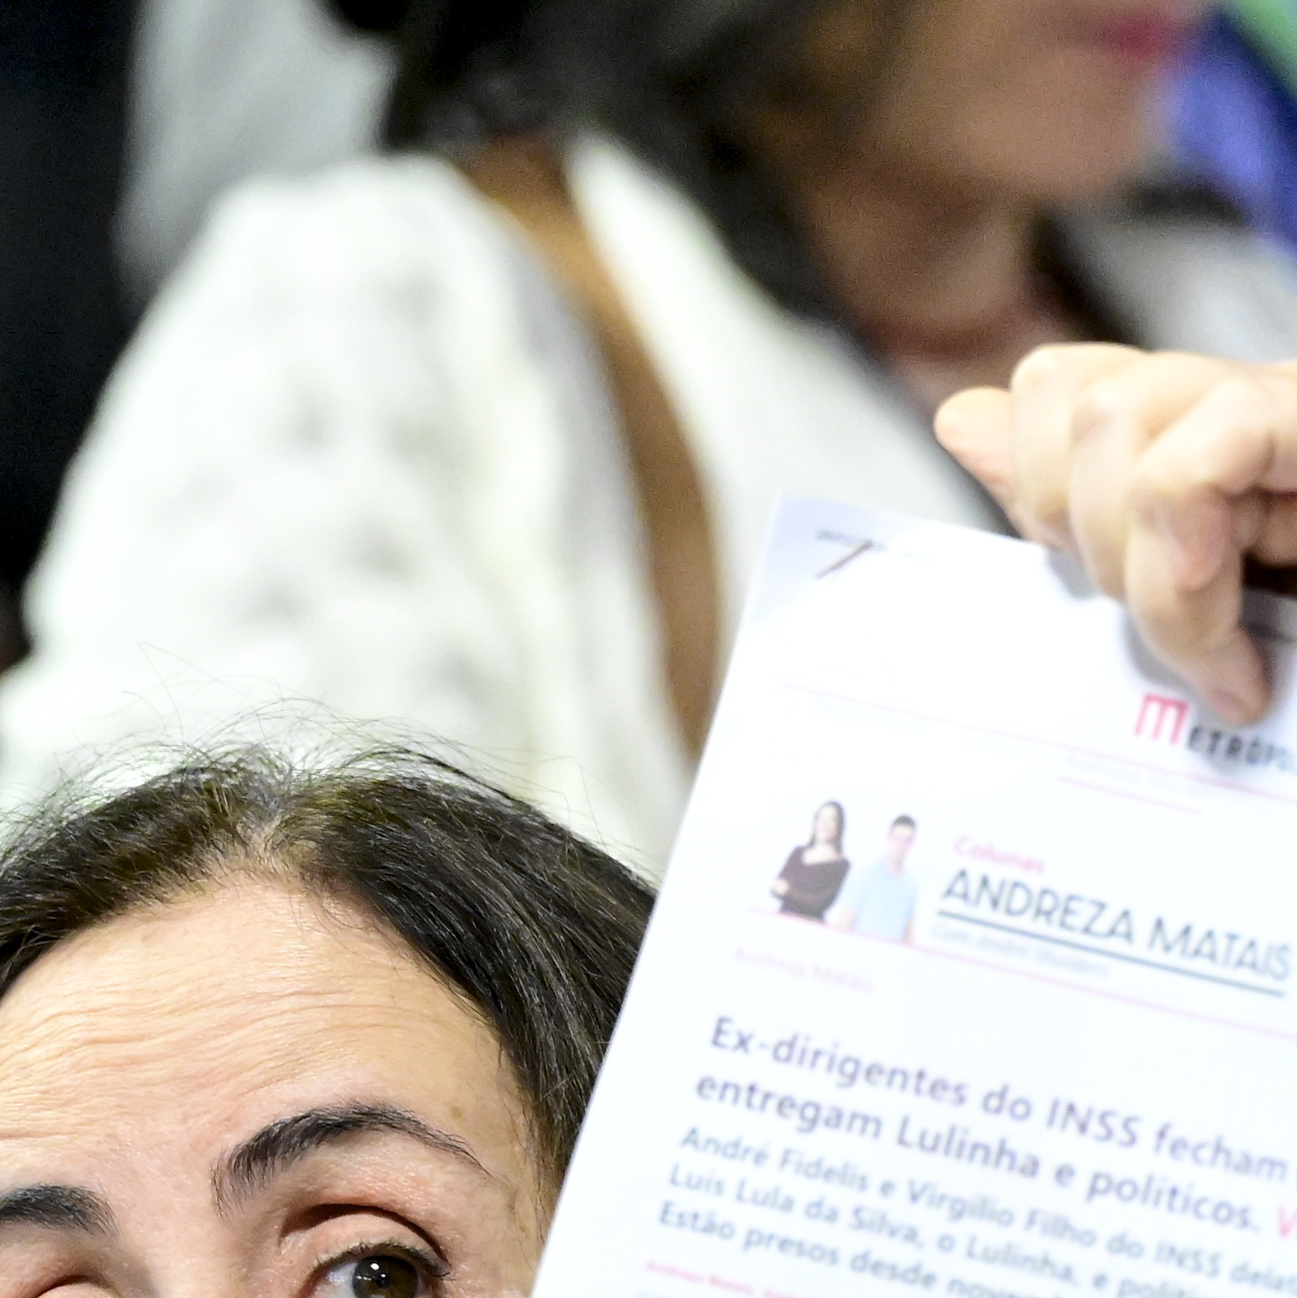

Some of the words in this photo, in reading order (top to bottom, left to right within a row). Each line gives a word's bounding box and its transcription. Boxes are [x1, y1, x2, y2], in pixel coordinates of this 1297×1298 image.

[941, 867, 1135, 946] ANDREZA
[1146, 915, 1293, 983] MATAIS
[695, 1072, 884, 1141] entregam
[896, 1112, 1042, 1180] Lulinha
[1053, 1160, 1077, 1189] e
[710, 1014, 969, 1107] Ex-dirigentes
[980, 1082, 1034, 1123] do
[1044, 1096, 1143, 1149] INSS
[1152, 1121, 1289, 1184] fecham
[657, 1198, 737, 1241] Estão
[742, 1226, 840, 1267] presos
[850, 1248, 939, 1292] desde
[679, 1124, 771, 1168] André
[778, 1146, 871, 1194] Fidelis
[879, 1175, 898, 1199] e
[1024, 1207, 1098, 1249] Filho
[1105, 1229, 1145, 1260] do
[1153, 1238, 1223, 1280] INSS
[736, 1177, 796, 1215] Lula
[804, 1196, 840, 1225] da
[849, 1204, 924, 1251] Silva,
[936, 1232, 957, 1254] o
[966, 1234, 1080, 1289] Lulinha,
[1091, 1272, 1110, 1292] e
